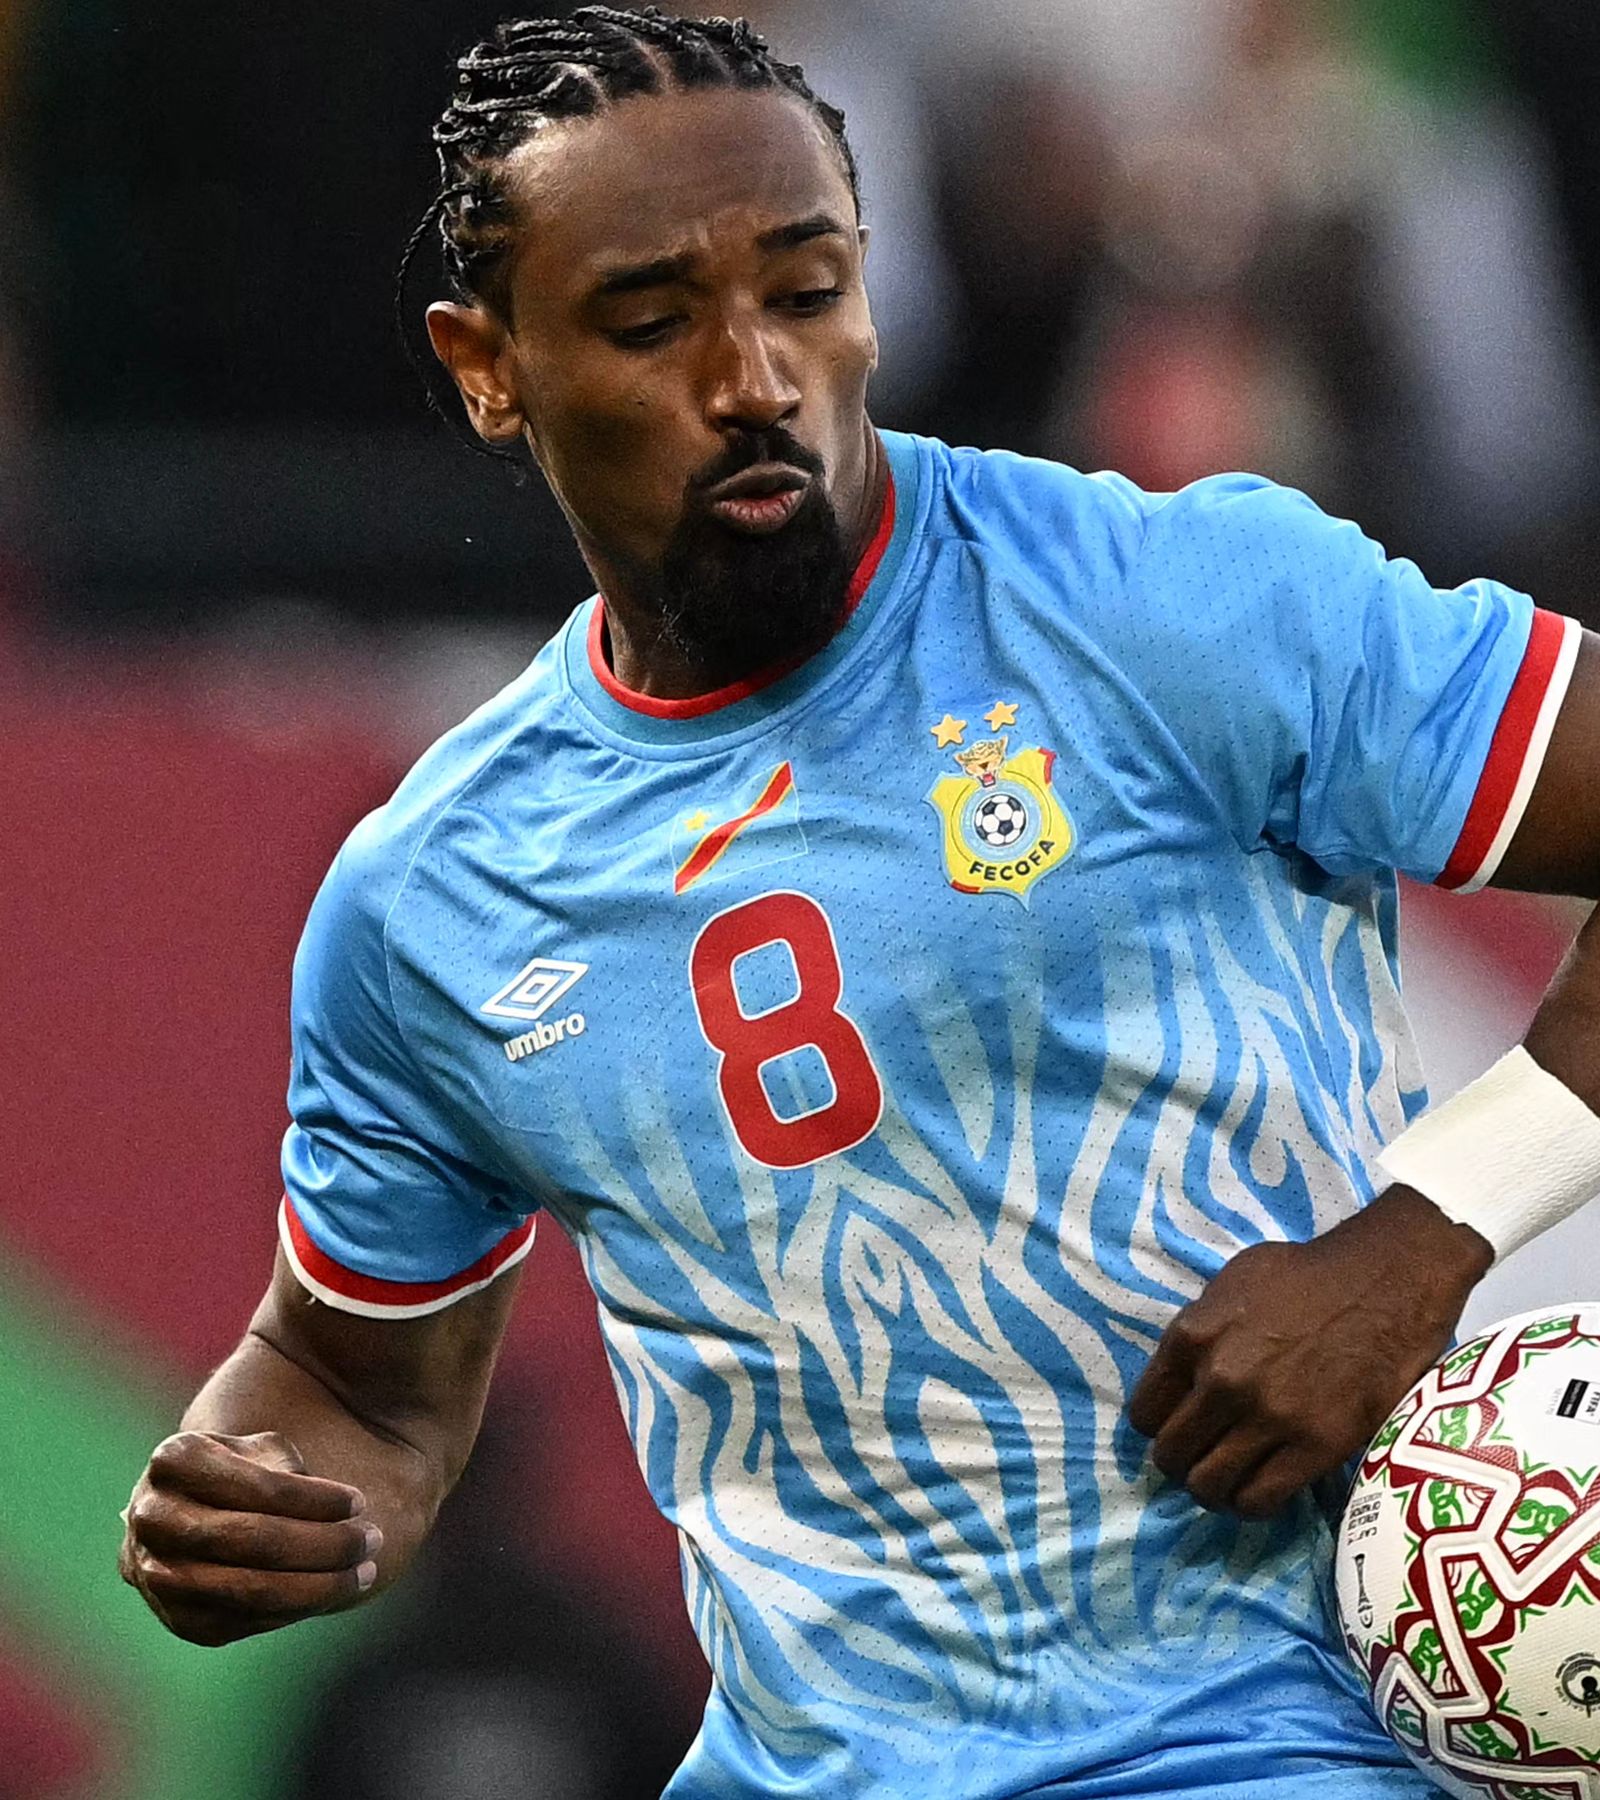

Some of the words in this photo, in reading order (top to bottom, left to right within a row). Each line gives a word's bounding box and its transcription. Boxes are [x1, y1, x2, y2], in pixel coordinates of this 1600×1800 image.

[969, 839, 1055, 881] FECOFA
[503, 1012, 586, 1063] umbro
[688, 888, 884, 1170] 8
